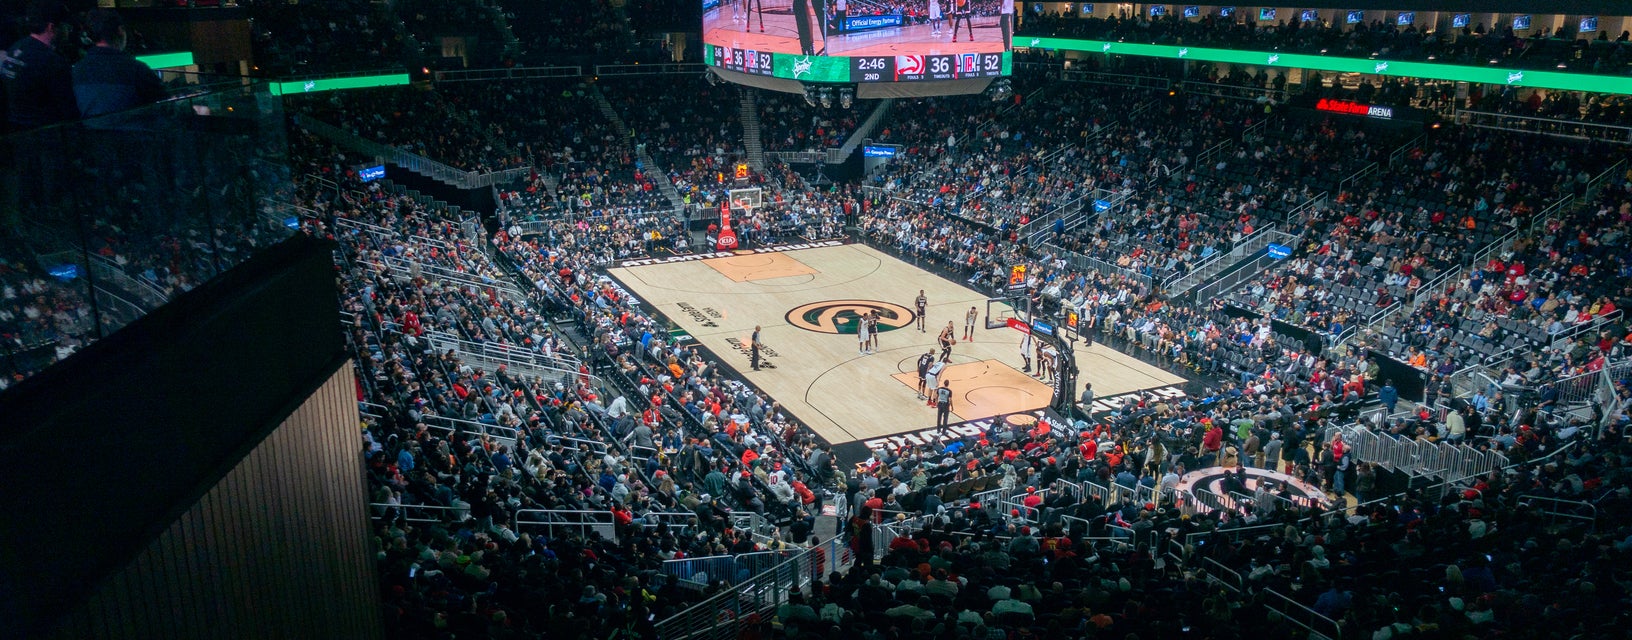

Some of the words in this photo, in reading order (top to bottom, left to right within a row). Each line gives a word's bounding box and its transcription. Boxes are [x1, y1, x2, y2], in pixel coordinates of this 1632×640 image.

[734, 50, 743, 66] 36
[760, 53, 771, 69] 52
[858, 58, 886, 70] 2:46
[984, 55, 999, 70] 52
[930, 57, 950, 73] 36
[864, 73, 880, 81] 2ND
[1367, 106, 1392, 117] ARENA
[720, 237, 733, 245] KIA
[754, 240, 843, 253] HAWKS
[621, 251, 735, 267] ATLANTA
[770, 475, 778, 485] 10
